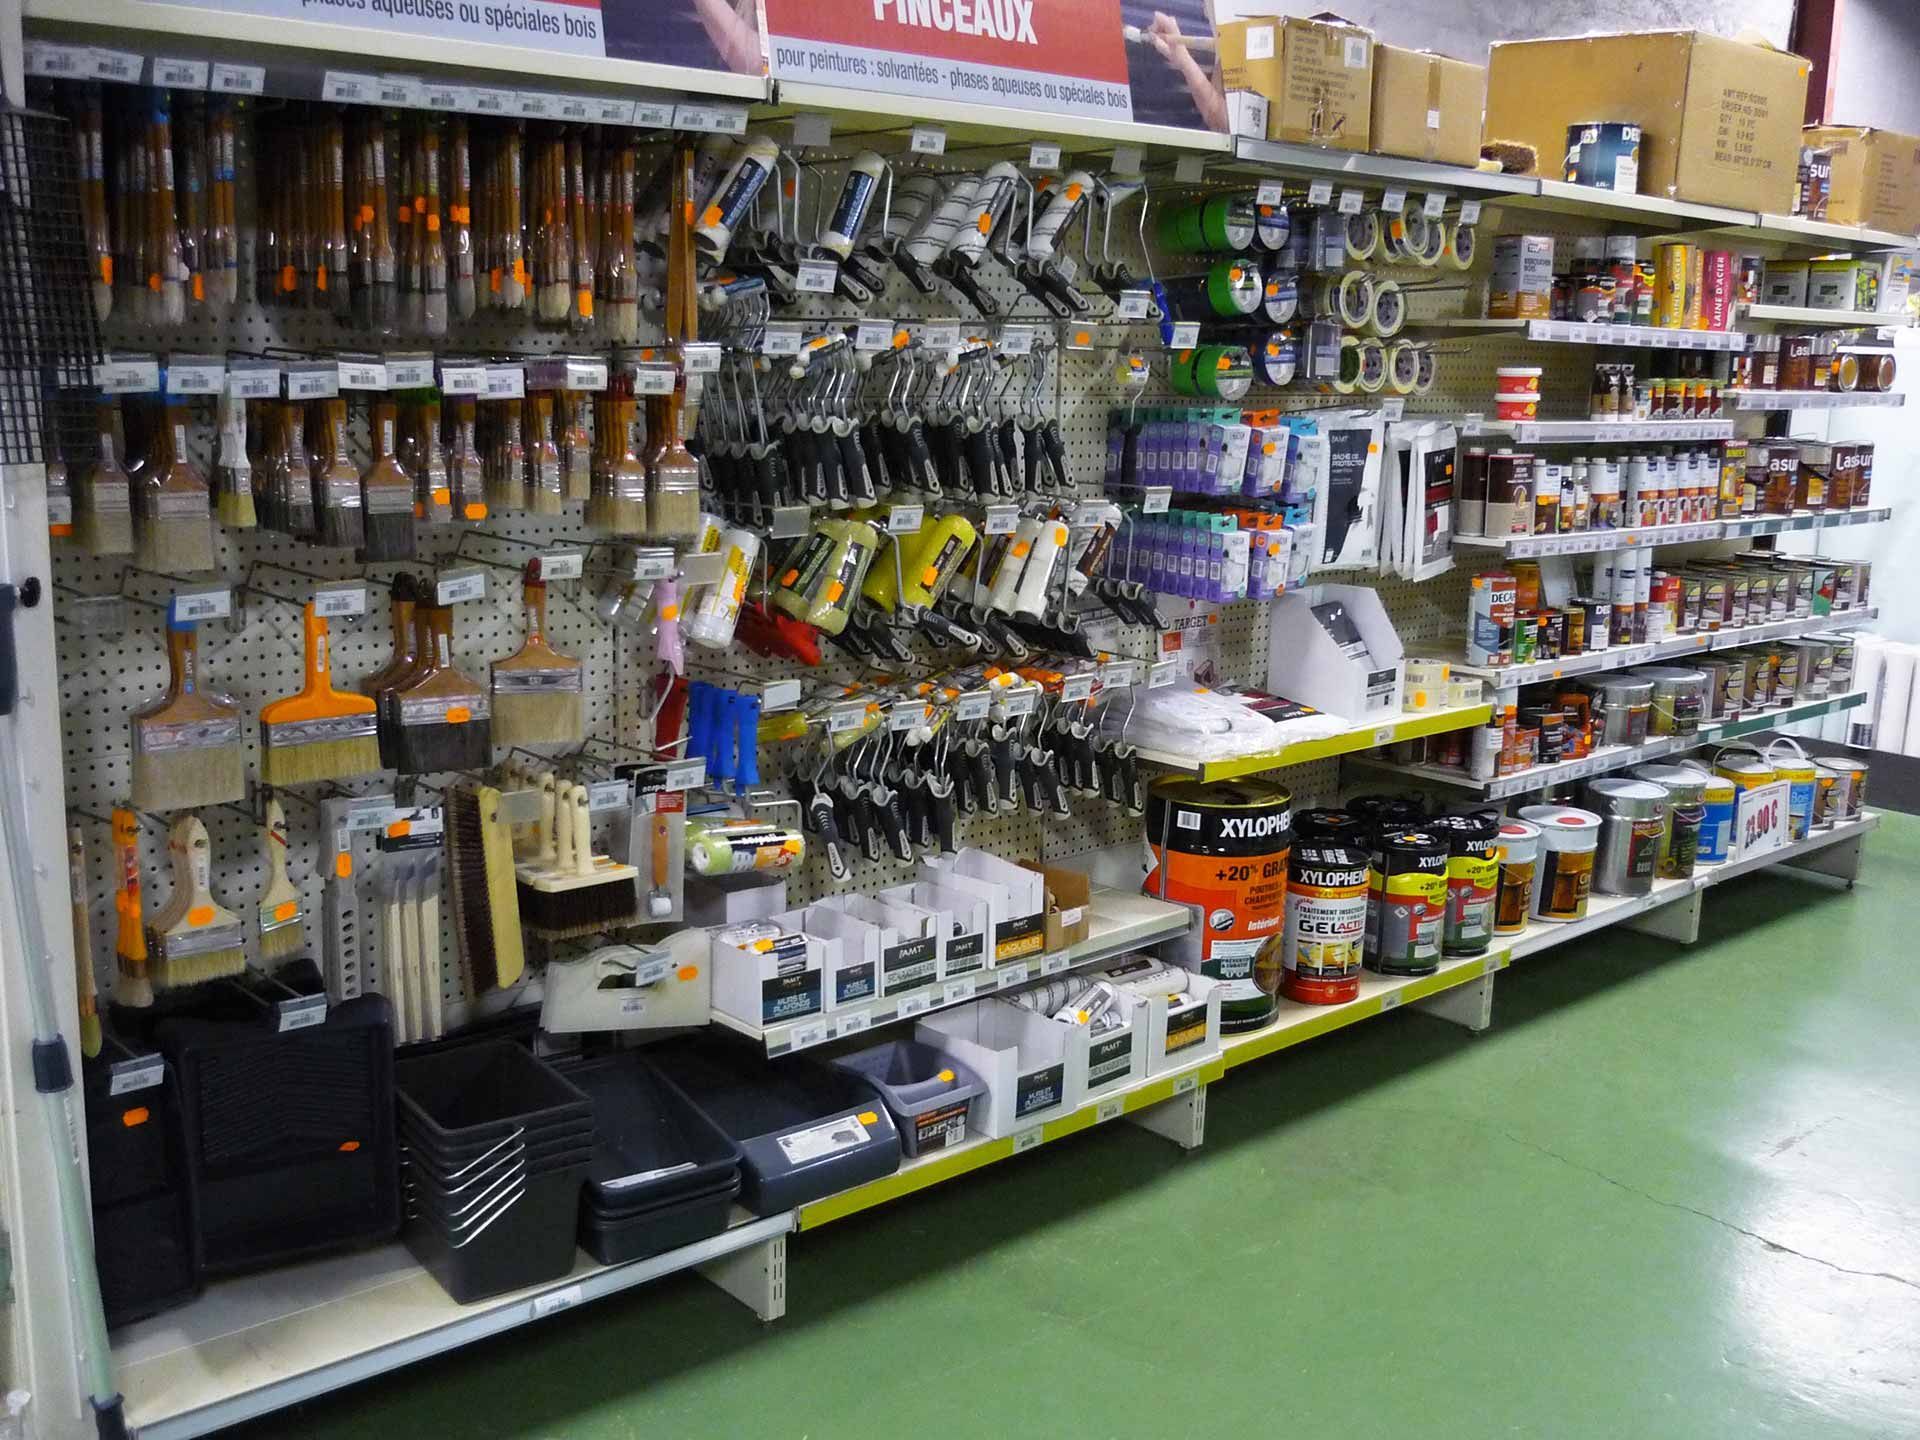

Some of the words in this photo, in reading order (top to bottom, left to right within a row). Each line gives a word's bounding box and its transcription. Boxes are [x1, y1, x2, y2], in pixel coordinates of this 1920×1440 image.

[372, 0, 454, 20] aqueuses
[459, 5, 480, 23] ou
[485, 4, 560, 34] spéciales
[565, 12, 597, 39] bois
[776, 48, 805, 69] pour
[809, 50, 868, 75] peintures
[877, 59, 939, 84] solvantées
[950, 67, 989, 91] phases
[992, 74, 1042, 97] aqueuses
[1044, 83, 1057, 99] ou
[1059, 82, 1106, 106] spéciales
[1107, 88, 1128, 108] bois
[1715, 257, 1725, 294] D'ACIER
[1713, 299, 1724, 327] LAINE
[1767, 457, 1800, 473] asur
[1174, 615, 1209, 631] TARGET
[642, 784, 667, 793] nespo
[1216, 863, 1258, 881] +20%
[1300, 905, 1338, 915] TRAITEMENT
[1299, 919, 1341, 934] GEL
